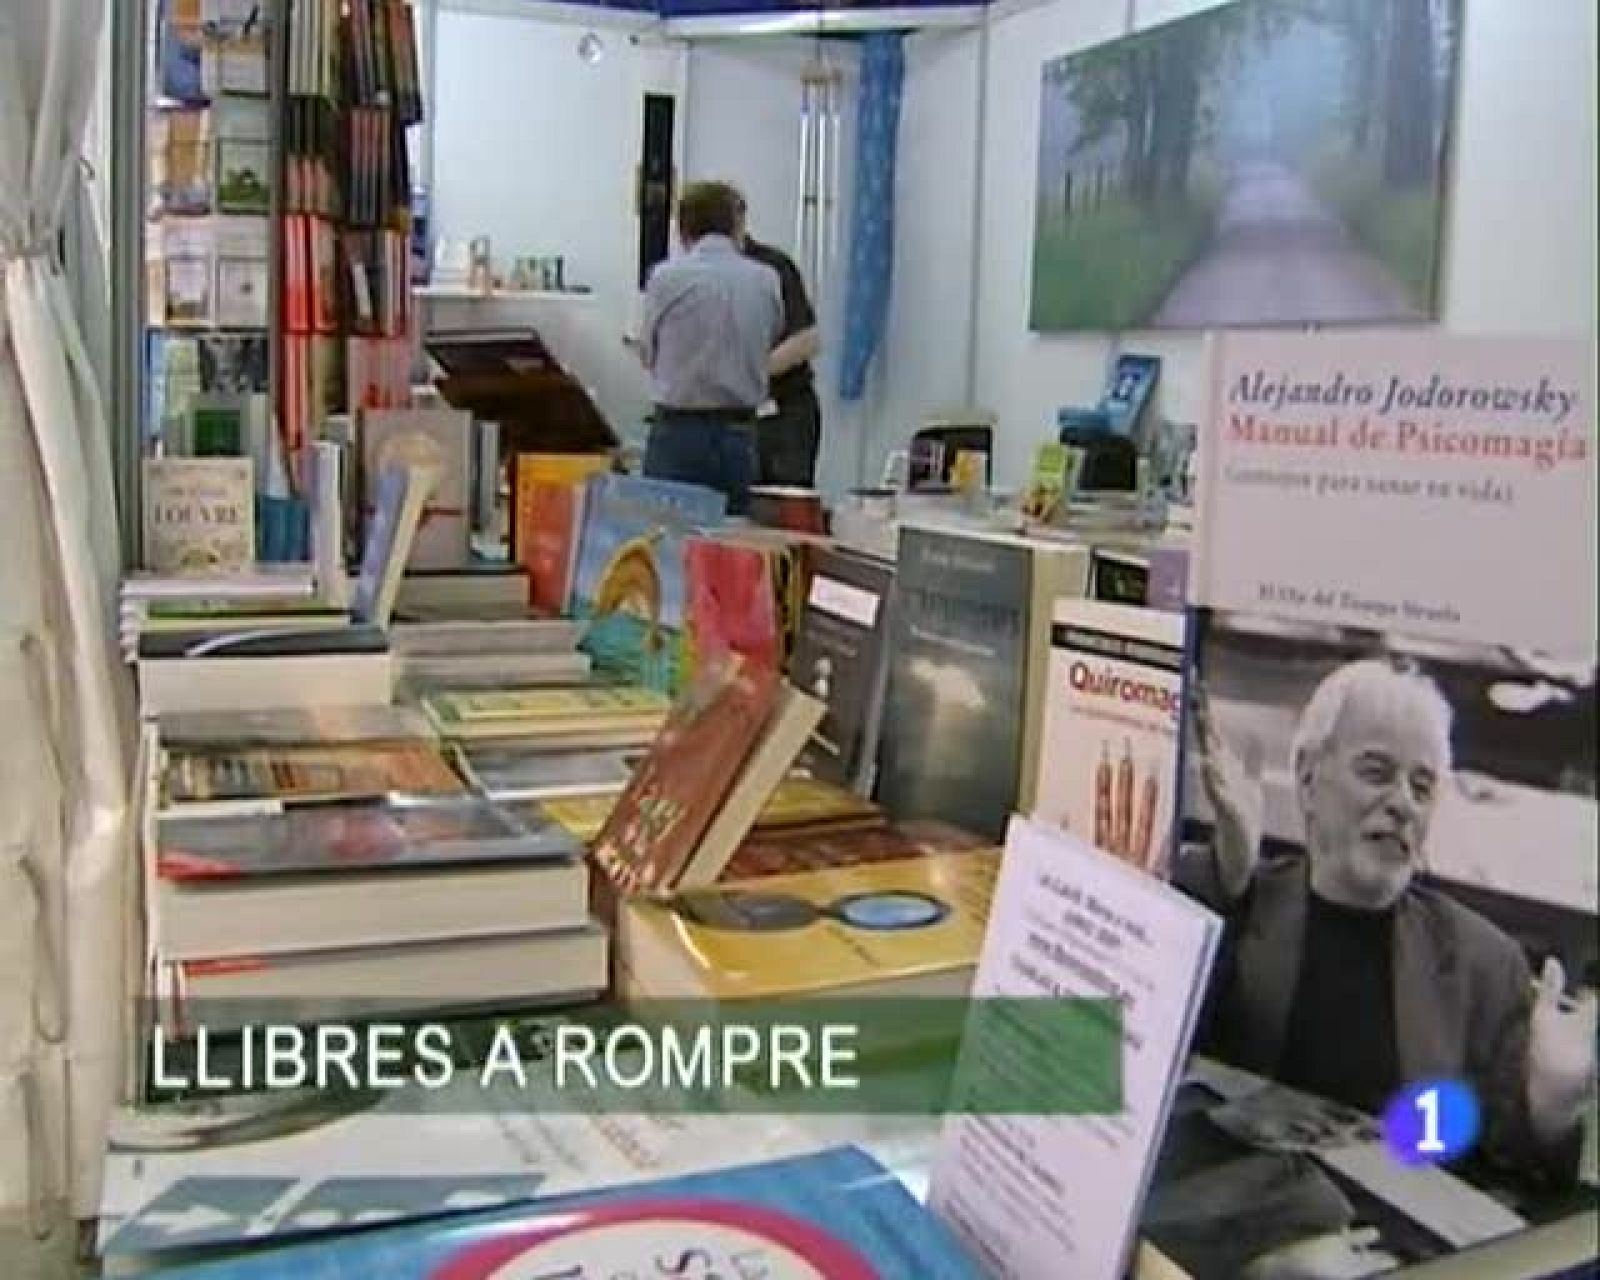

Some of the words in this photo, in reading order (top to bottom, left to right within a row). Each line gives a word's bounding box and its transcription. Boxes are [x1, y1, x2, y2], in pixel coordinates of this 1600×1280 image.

[1228, 369, 1374, 411] Alejandro
[1377, 375, 1579, 421] Jodorowsky
[1227, 414, 1338, 447] Manual
[1349, 418, 1386, 450] de
